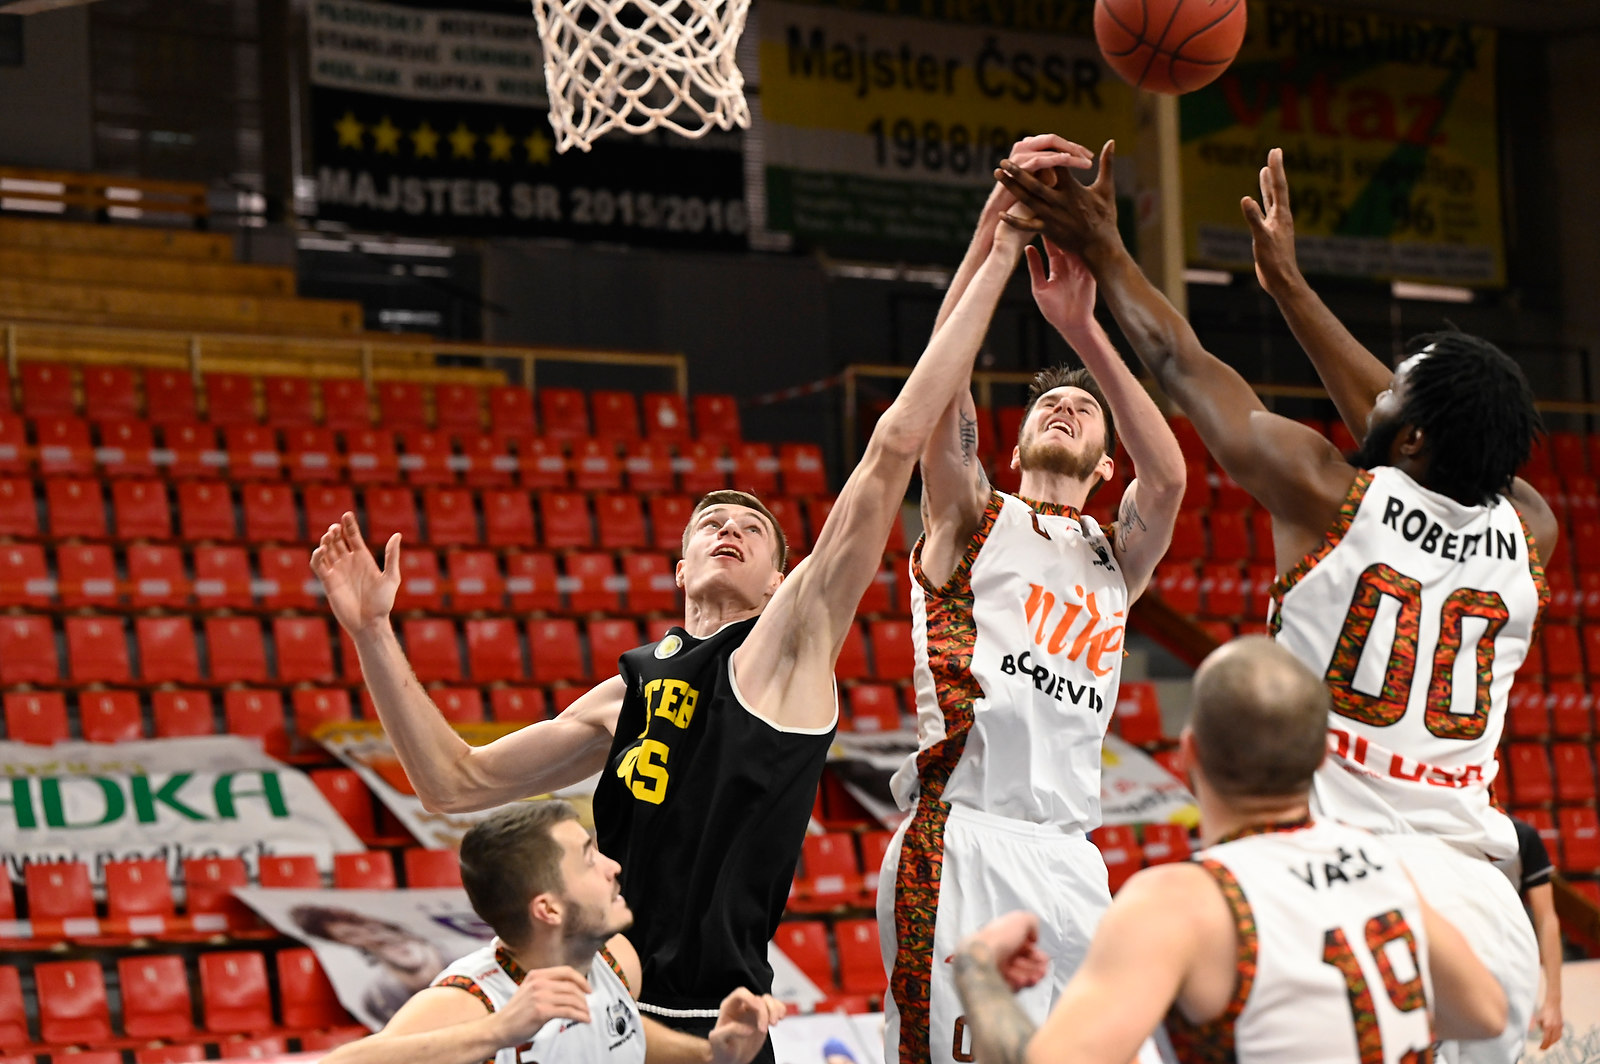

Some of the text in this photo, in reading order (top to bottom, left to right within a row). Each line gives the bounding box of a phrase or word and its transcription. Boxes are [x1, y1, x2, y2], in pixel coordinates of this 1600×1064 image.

[787, 24, 1103, 109] Majster ČSSR
[868, 117, 1029, 175] 1988/8
[316, 166, 502, 218] MAJSTER
[510, 181, 563, 223] SR
[570, 186, 748, 236] 2015/2016
[1326, 562, 1510, 740] 00
[1322, 908, 1432, 1064] 19
